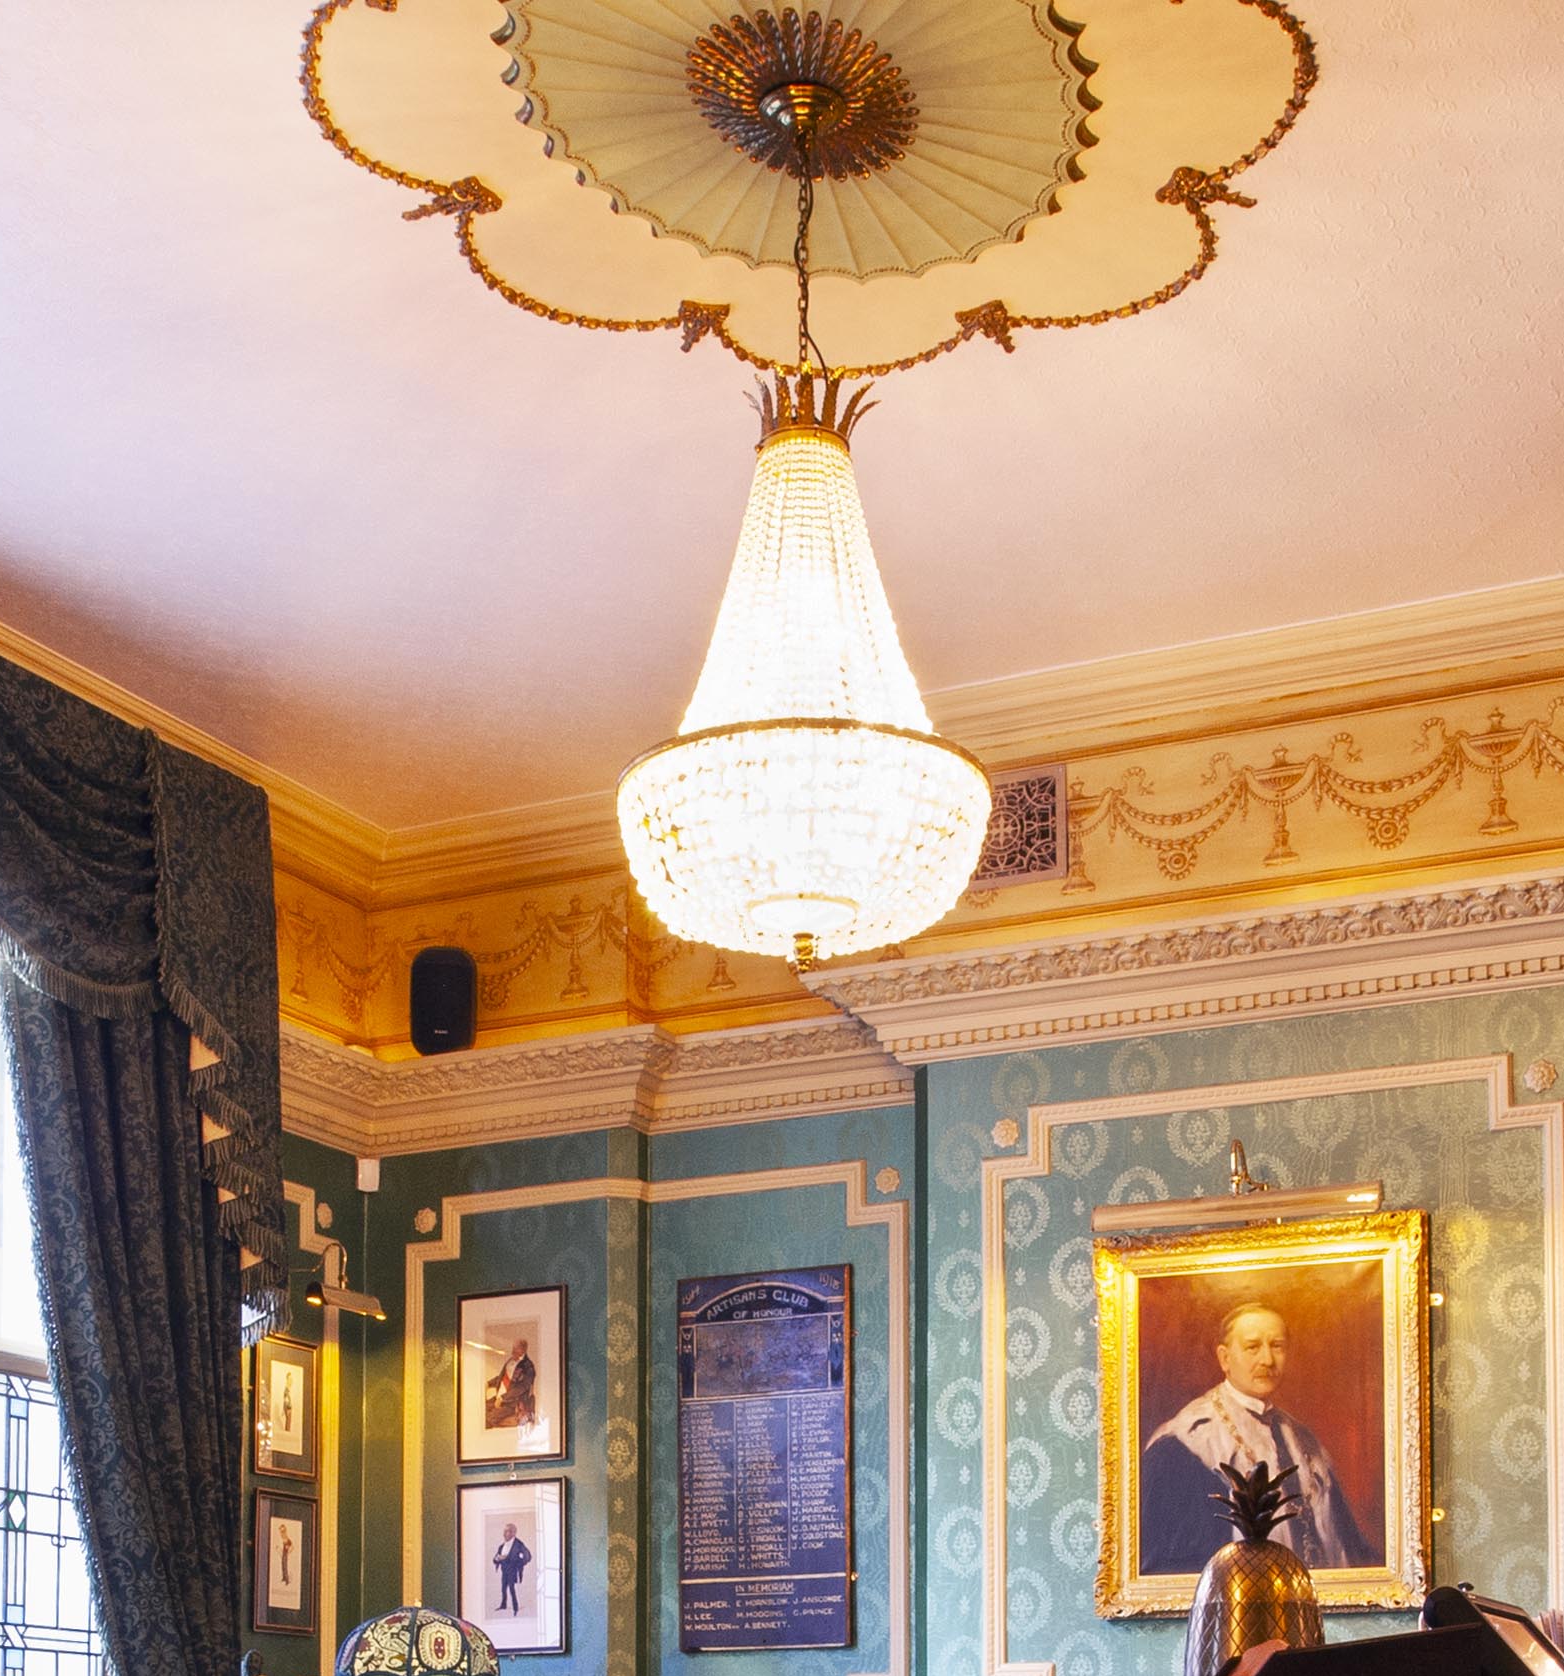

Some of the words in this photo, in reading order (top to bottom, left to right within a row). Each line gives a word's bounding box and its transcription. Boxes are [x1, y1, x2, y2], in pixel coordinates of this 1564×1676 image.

[706, 1289, 767, 1320] ARTISANS
[772, 1289, 809, 1308] CLUB
[733, 1311, 747, 1319] OF
[753, 1307, 793, 1318] HONOUR
